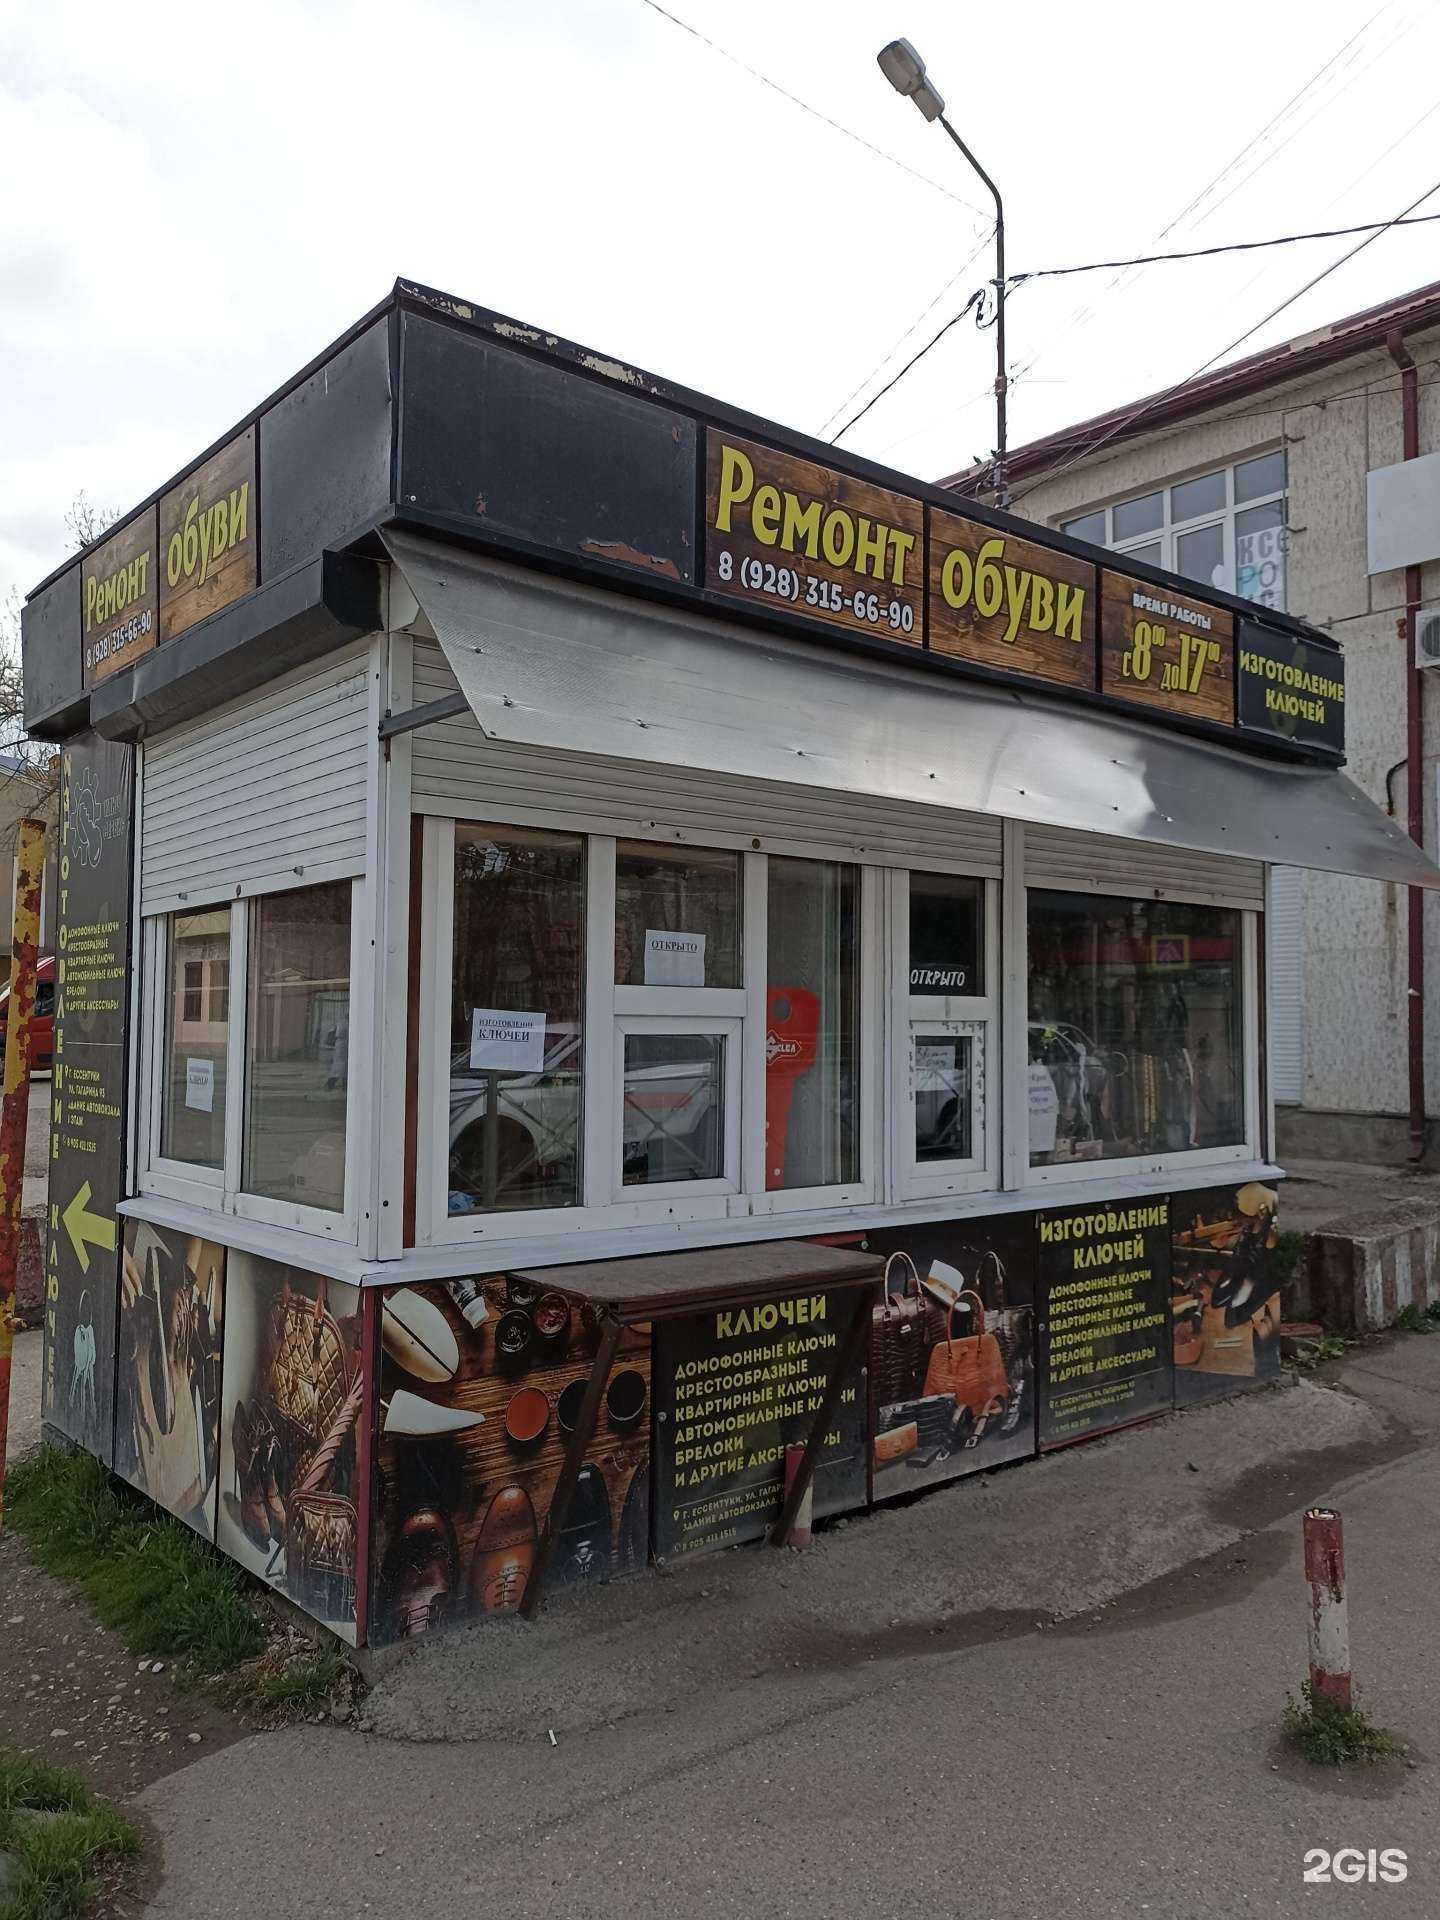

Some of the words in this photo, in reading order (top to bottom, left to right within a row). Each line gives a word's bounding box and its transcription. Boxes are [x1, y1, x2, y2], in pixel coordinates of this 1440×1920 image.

[86, 551, 150, 632] Ремонт
[167, 481, 249, 587] обуви
[715, 445, 915, 585] Ремонт
[941, 540, 1084, 643] обуви
[718, 551, 733, 580] 8
[740, 556, 800, 601] (928)
[805, 575, 915, 632] 315-66-90
[1132, 592, 1169, 616] ВРЕМЯ
[1169, 604, 1212, 631] РАБОТЫ
[86, 649, 93, 669] 8
[92, 635, 112, 664] (928)
[111, 609, 152, 652] 315-66-90
[1240, 649, 1345, 703] ИЗГОТОВЛЕНИЕ
[1265, 689, 1325, 724] КЛЮЧЕЙ
[651, 940, 698, 952] ОТКРЫТО
[910, 969, 966, 987] ОТКРЫТО
[1040, 1205, 1168, 1243] ИЗГОТОВЛЕНИЕ
[1074, 1234, 1144, 1269] КЛЮЧЕЙ
[716, 1294, 827, 1339] КЛЮЧЕЙ
[674, 1343, 784, 1381] ДОМОФОННЫЕ
[787, 1333, 836, 1357] КЛЮЧИ
[1049, 1346, 1093, 1367] БРЕЛОКИ
[675, 1358, 808, 1401] КРЕСТООБРАЗНЫЕ
[675, 1386, 773, 1423] КВАРТИРНЫЕ
[777, 1374, 827, 1398] КЛЮЧИ
[674, 1400, 804, 1444] АВТОМОБИЛЬНЫЕ
[675, 1435, 744, 1466] БРЕЛОКИ
[675, 1473, 685, 1488] И
[689, 1458, 744, 1486] ДРУГИЕ
